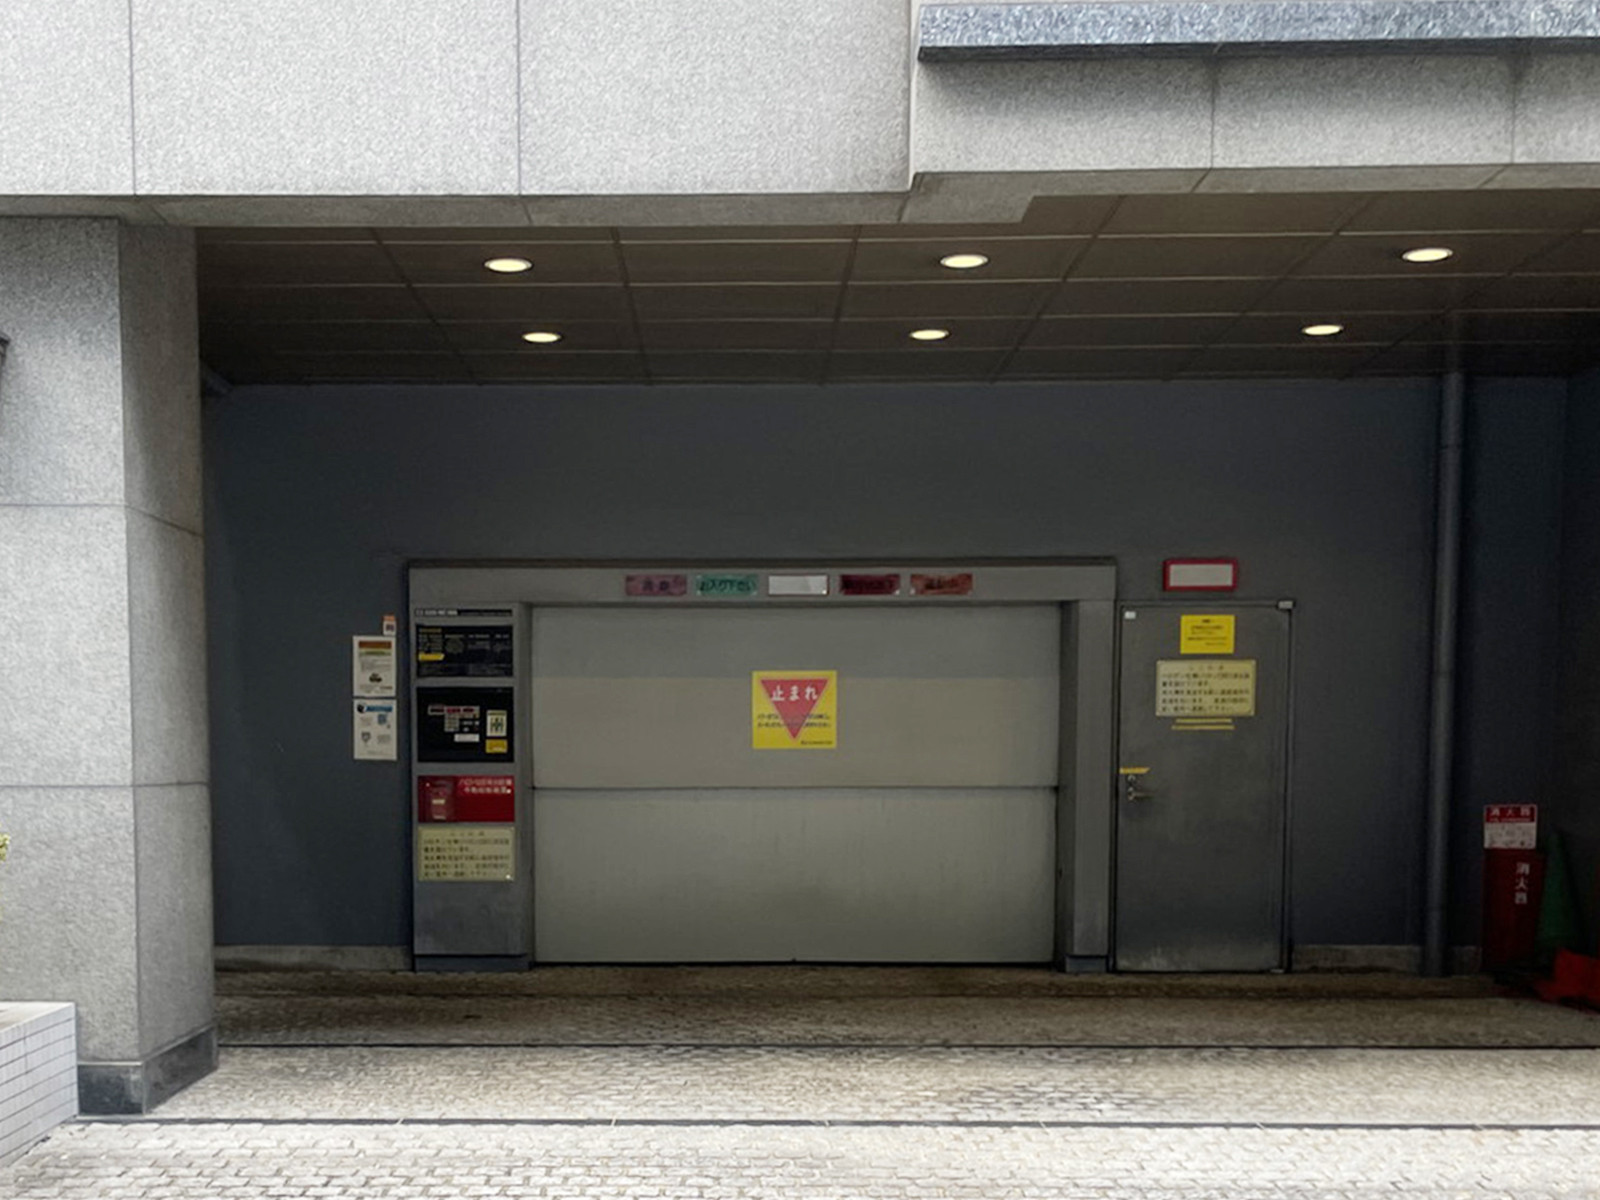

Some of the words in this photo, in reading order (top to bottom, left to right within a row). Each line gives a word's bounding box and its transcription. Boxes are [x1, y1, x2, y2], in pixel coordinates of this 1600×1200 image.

[771, 685, 818, 701] 止まれ
[1514, 861, 1531, 905] 消火器
